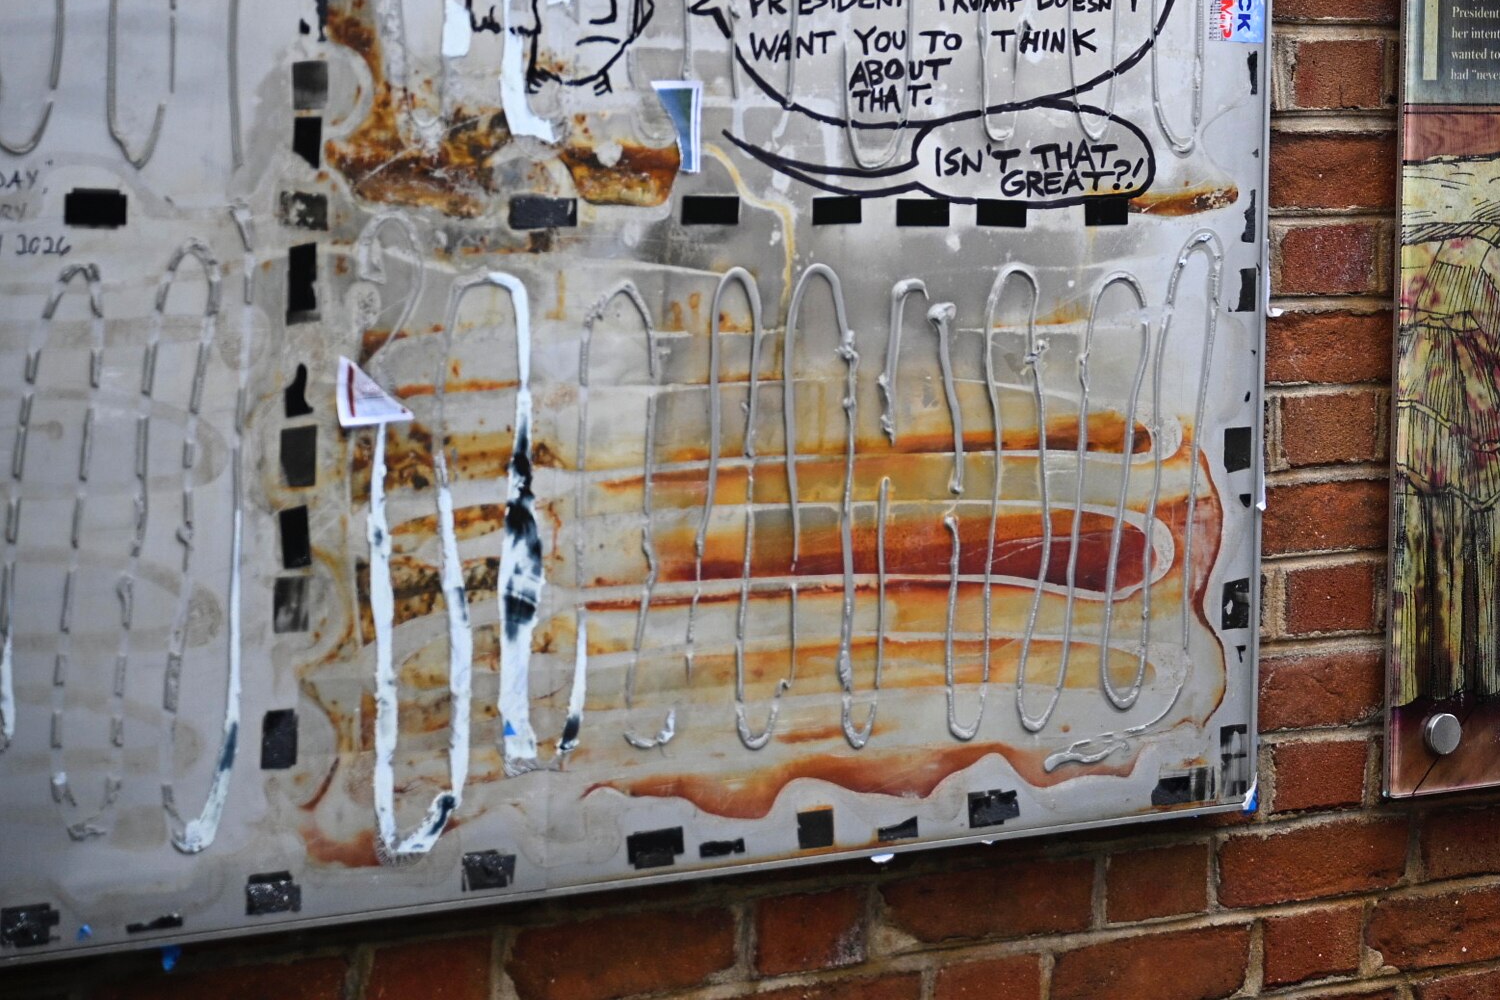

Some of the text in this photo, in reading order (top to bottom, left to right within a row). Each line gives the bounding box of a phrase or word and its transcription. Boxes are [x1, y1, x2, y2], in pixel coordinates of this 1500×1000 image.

[750, 25, 1097, 63] WANT YOU TO THINK
[1451, 26, 1469, 39] her
[1450, 47, 1488, 60] wanted
[1490, 49, 1500, 60] to
[849, 58, 952, 91] ABOUT
[1450, 67, 1470, 81] had
[852, 83, 932, 114] THAT.
[935, 139, 1118, 177] ISN'T THAT
[1001, 157, 1144, 197] GREAT?!
